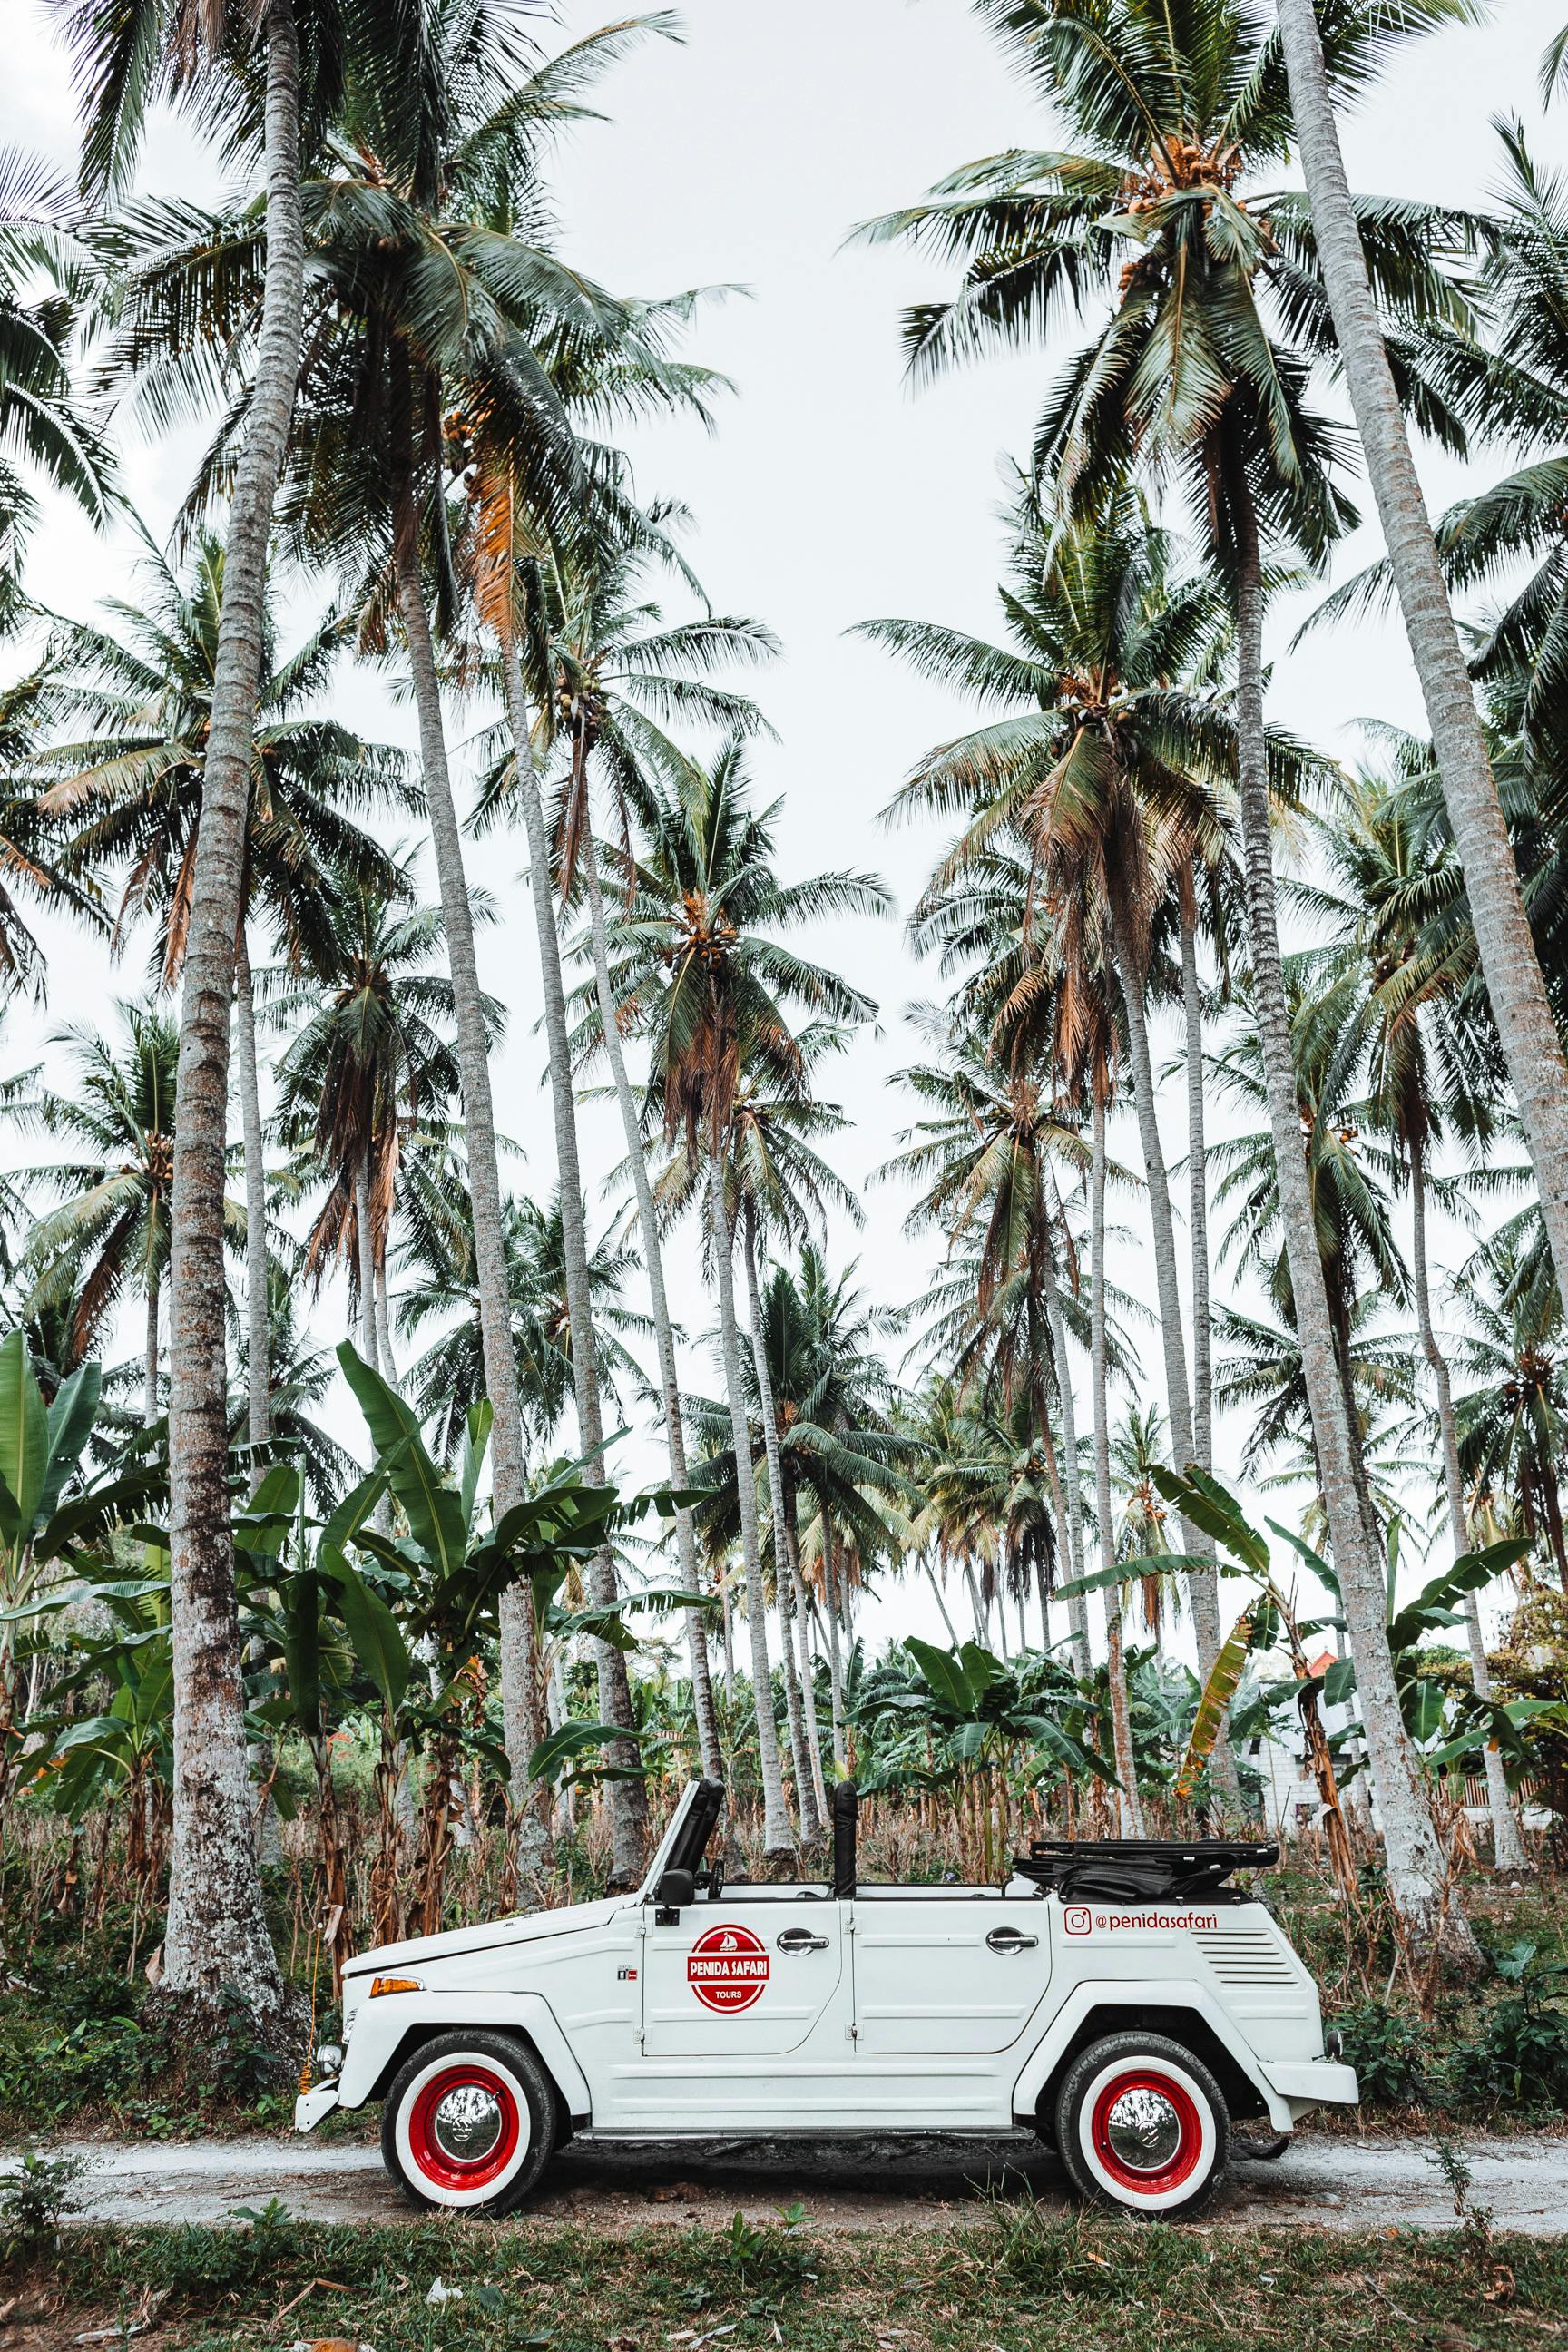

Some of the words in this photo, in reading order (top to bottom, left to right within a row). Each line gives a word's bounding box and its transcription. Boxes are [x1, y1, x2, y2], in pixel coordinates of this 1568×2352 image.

[1095, 1912, 1218, 1931] @penidasafari
[690, 1961, 730, 1976] PENIDA
[731, 1960, 767, 1975] SAFARI
[715, 1991, 742, 1999] TOURS
